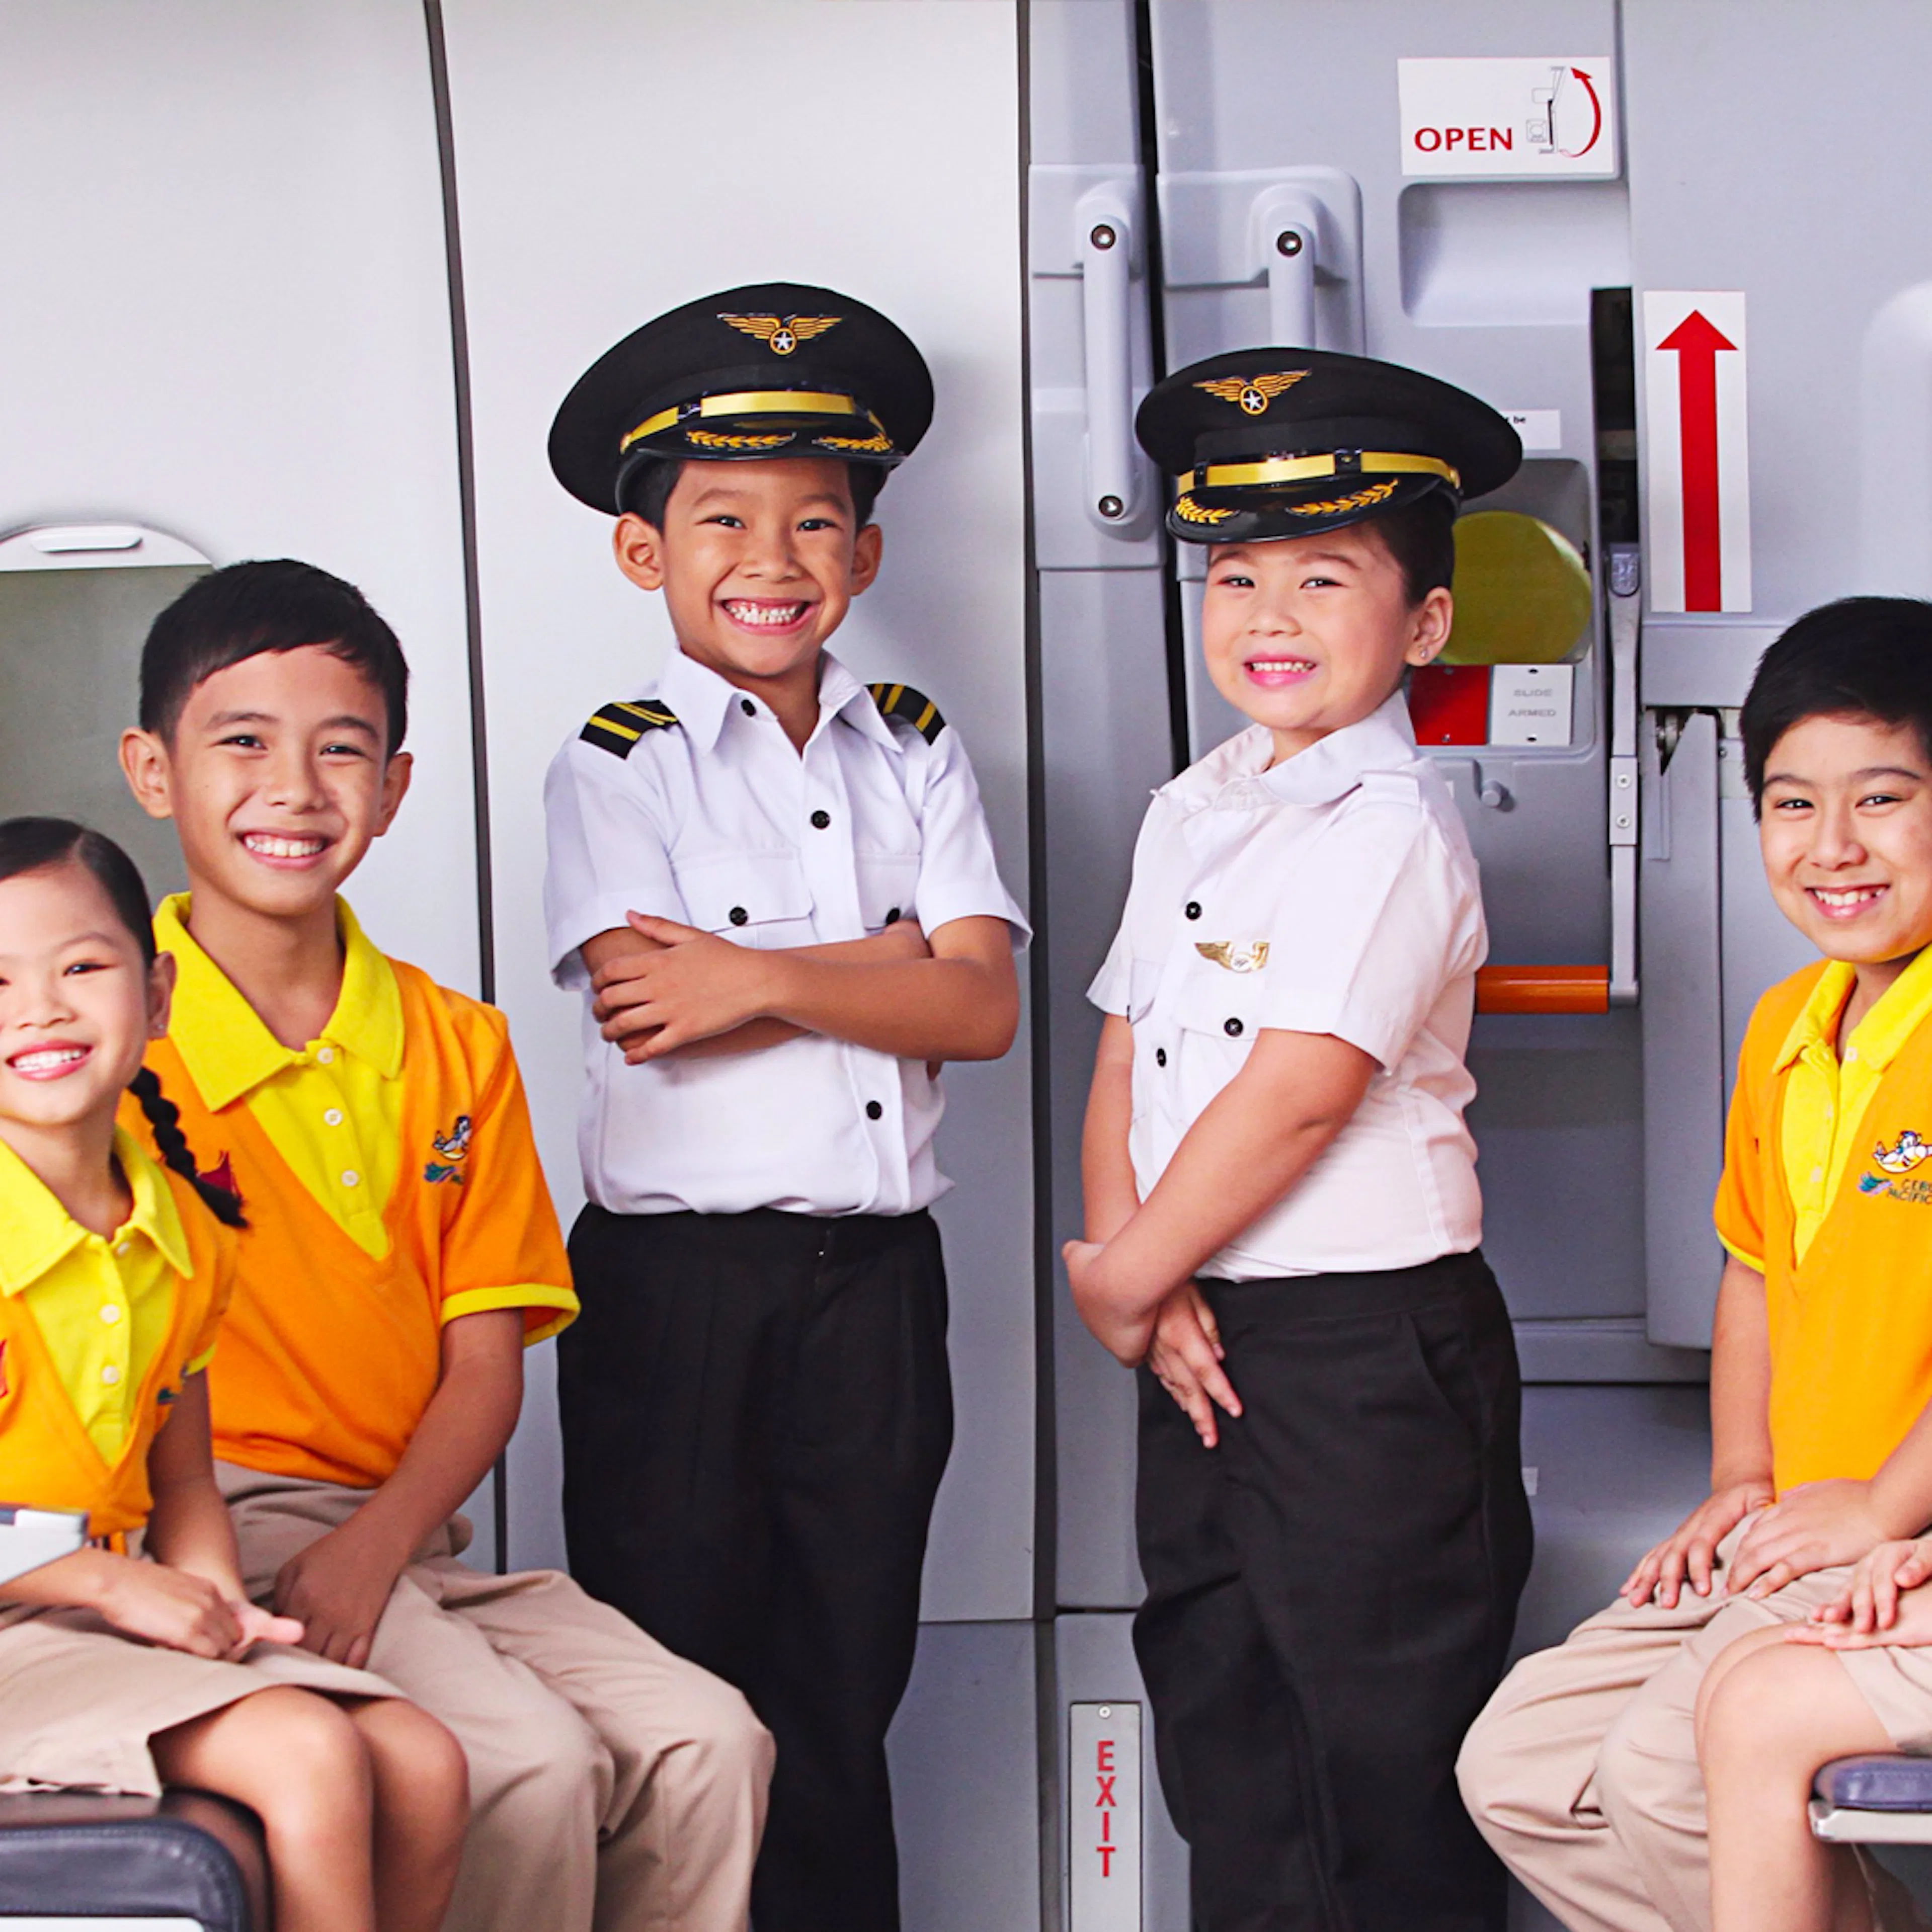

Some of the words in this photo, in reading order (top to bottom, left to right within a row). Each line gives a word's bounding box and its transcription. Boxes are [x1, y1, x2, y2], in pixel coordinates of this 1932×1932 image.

[1414, 127, 1513, 151] OPEN
[1513, 688, 1553, 697] SLIDE
[1508, 708, 1556, 717] ARMED
[1095, 1740, 1117, 1878] EXIT
